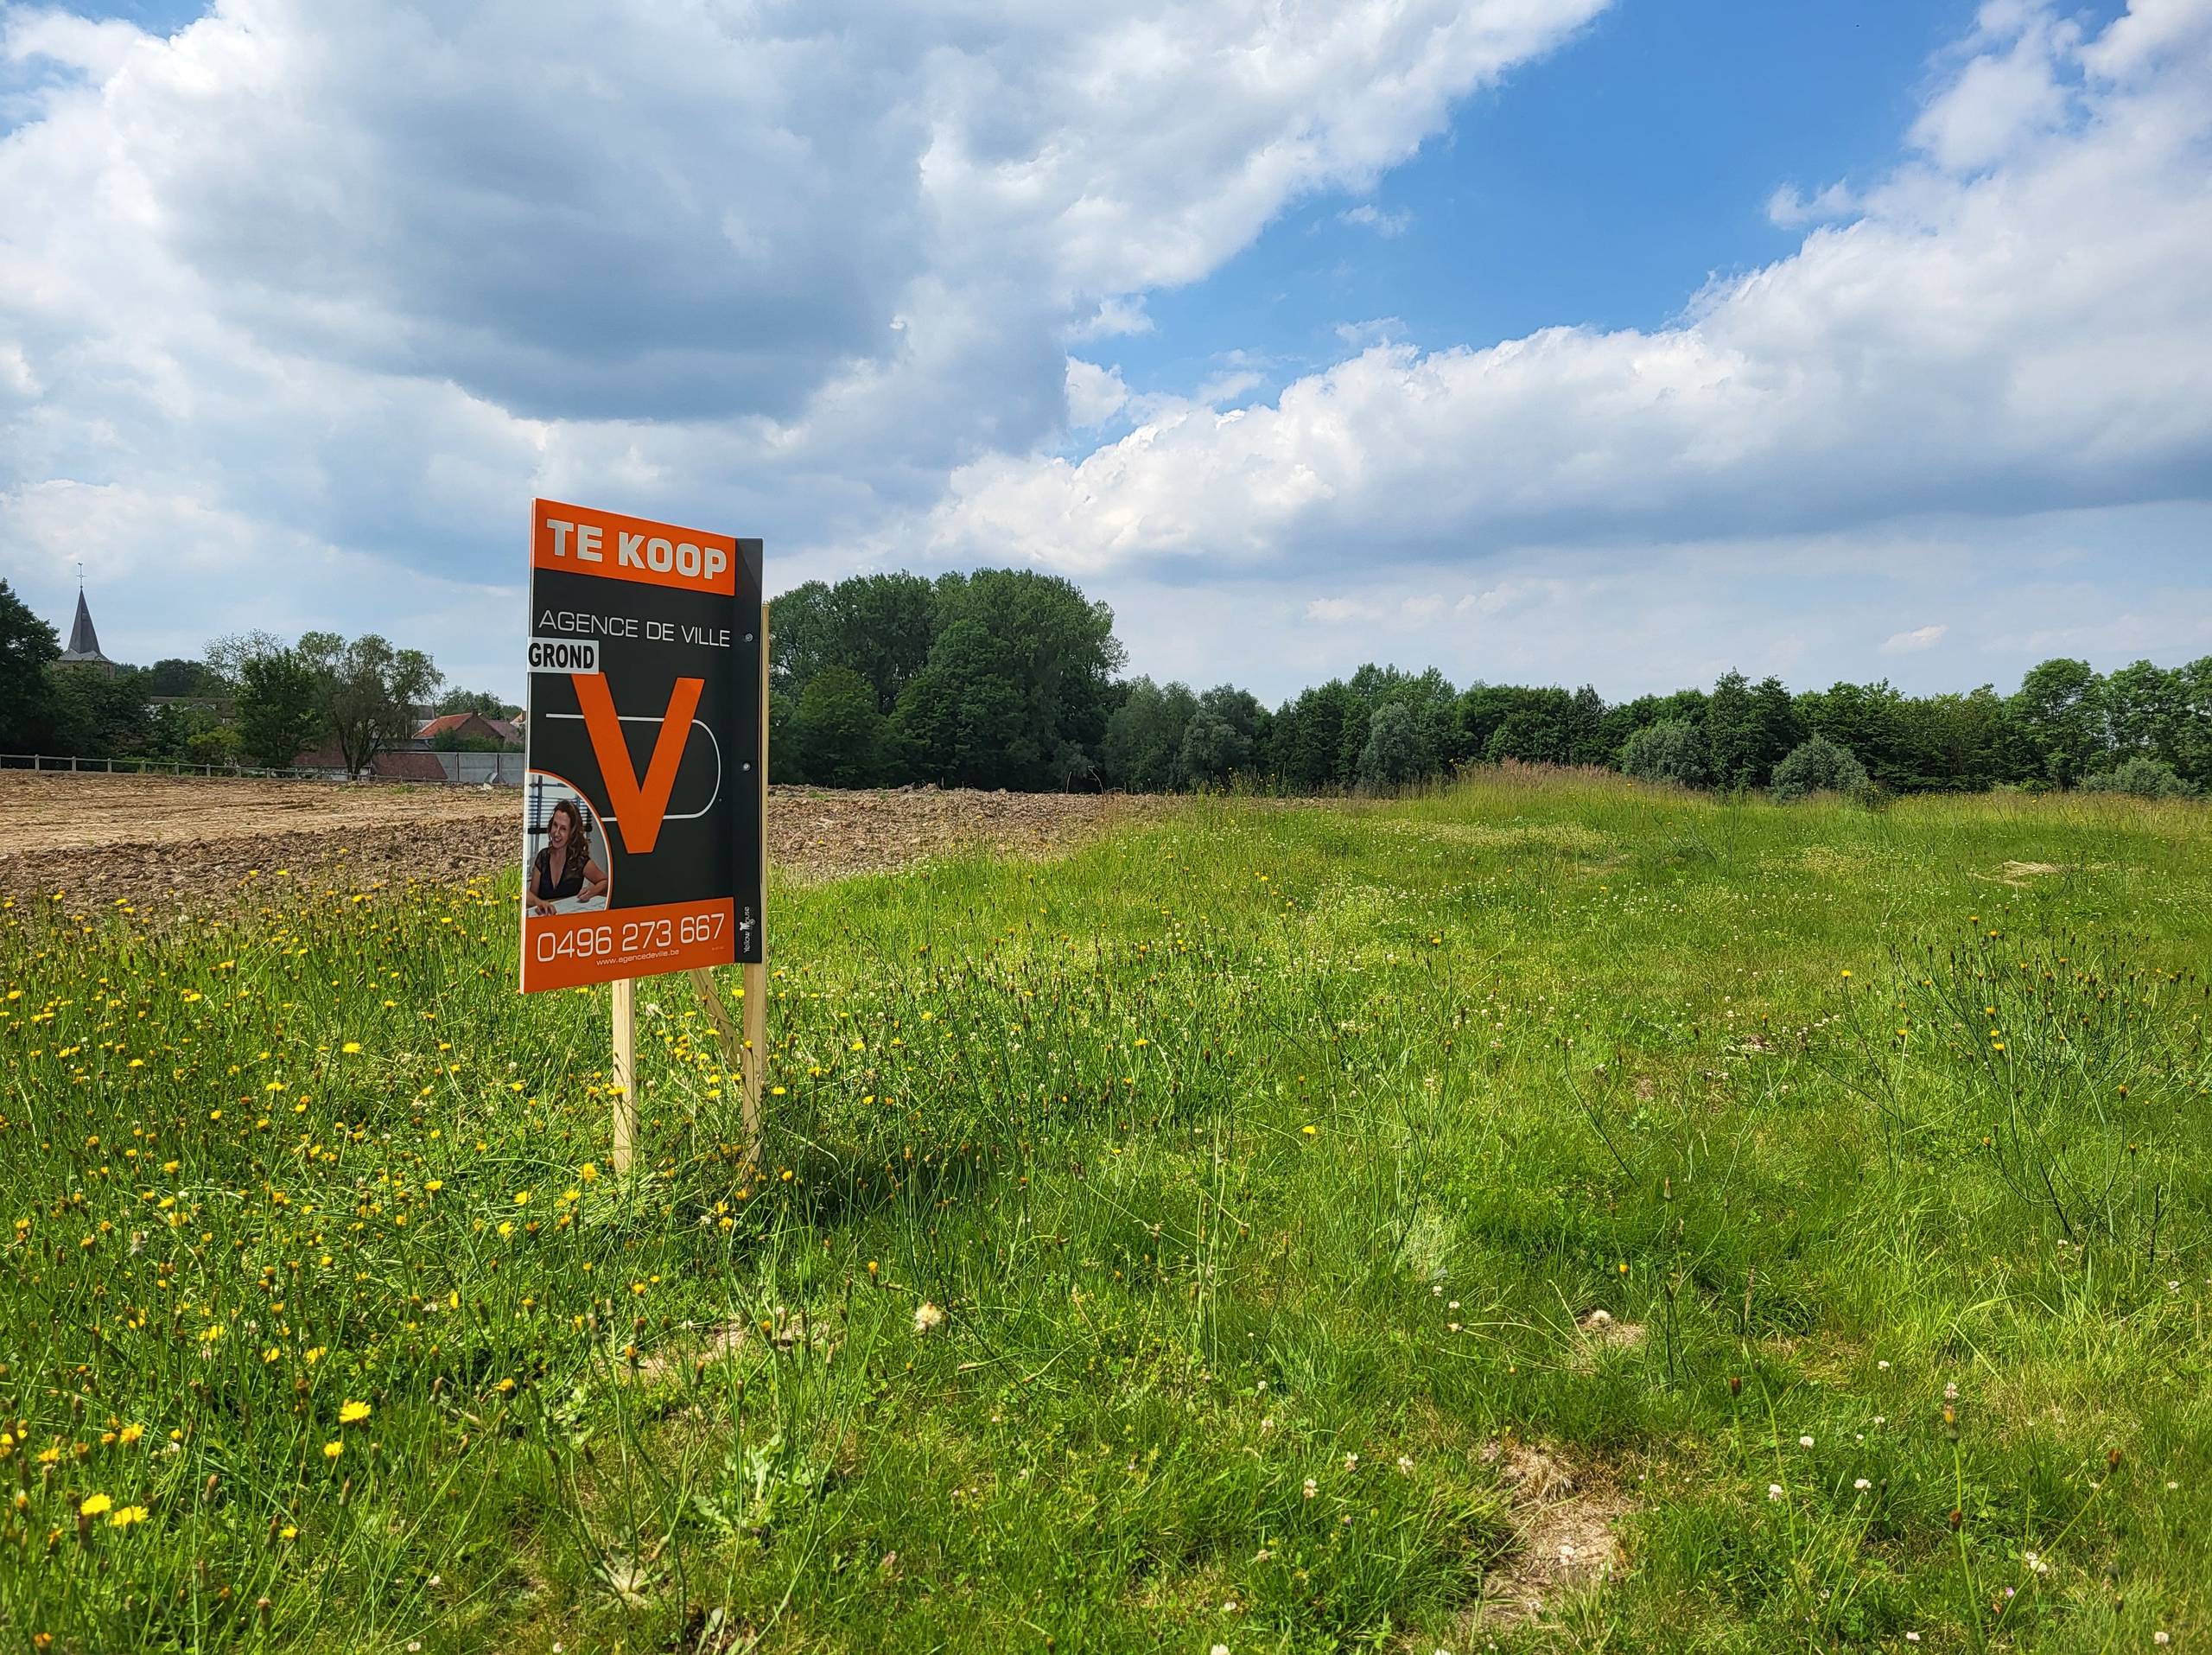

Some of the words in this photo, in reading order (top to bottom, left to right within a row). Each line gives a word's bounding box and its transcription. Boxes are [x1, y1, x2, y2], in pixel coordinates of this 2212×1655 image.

[546, 519, 603, 563] TE
[618, 532, 727, 580] KOOP
[538, 609, 639, 638] AGENCE
[646, 621, 675, 642] DE
[681, 624, 731, 647] VILLE
[528, 642, 594, 669] GROND
[537, 926, 612, 963] 0496
[621, 919, 671, 952] 273
[680, 913, 725, 945] 667
[596, 949, 679, 966] www.agencedeville.be
